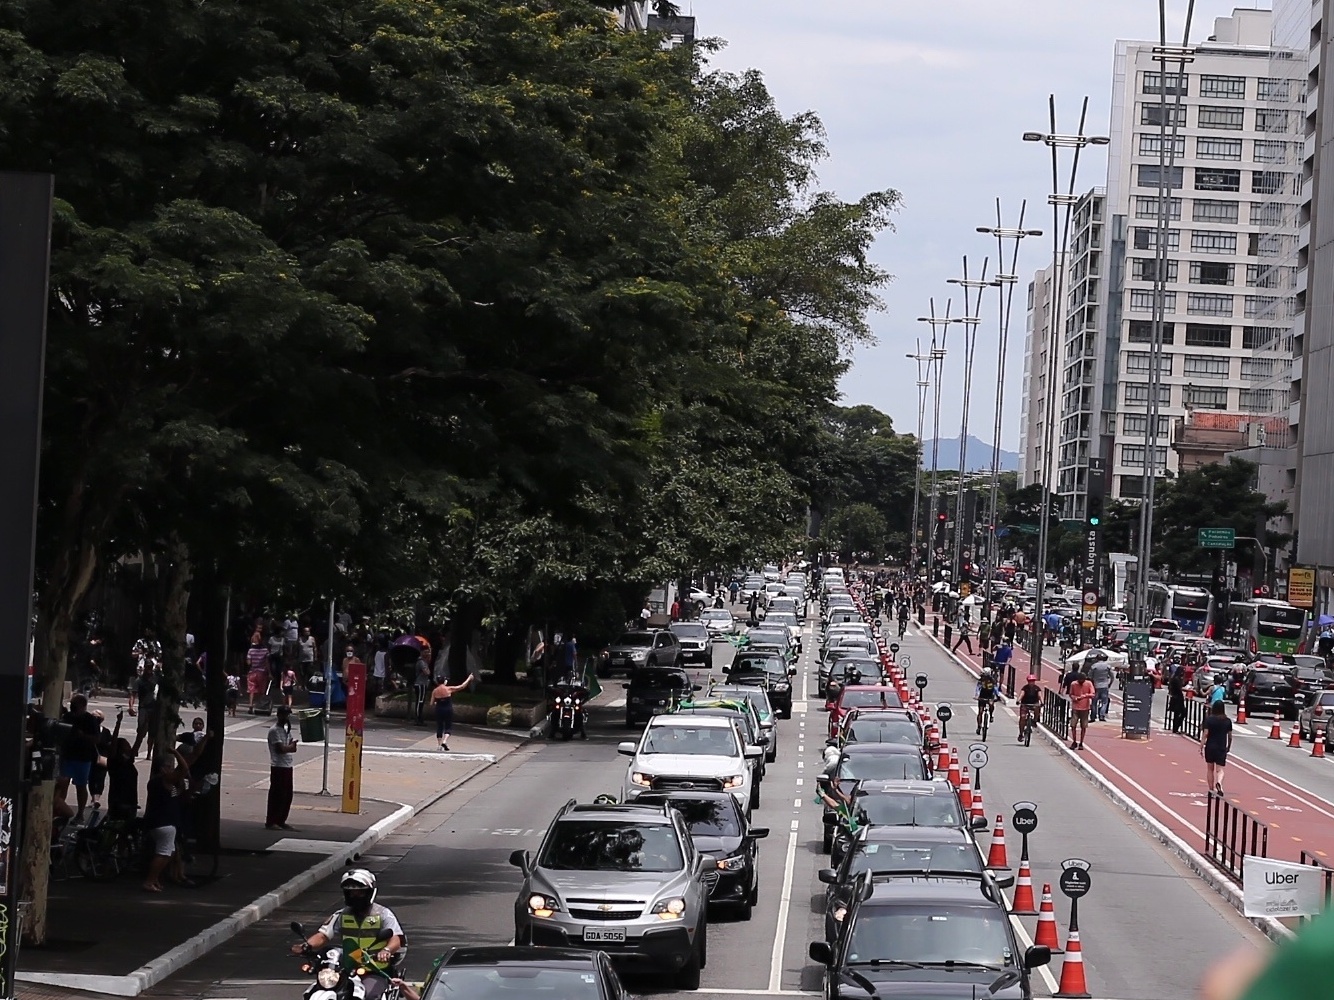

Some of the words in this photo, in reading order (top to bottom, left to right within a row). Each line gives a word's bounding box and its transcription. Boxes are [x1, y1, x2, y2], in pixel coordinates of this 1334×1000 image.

[1086, 530, 1096, 573] Augusta
[1085, 575, 1094, 584] R.
[1015, 817, 1035, 825] Uber
[1265, 871, 1299, 885] Uber
